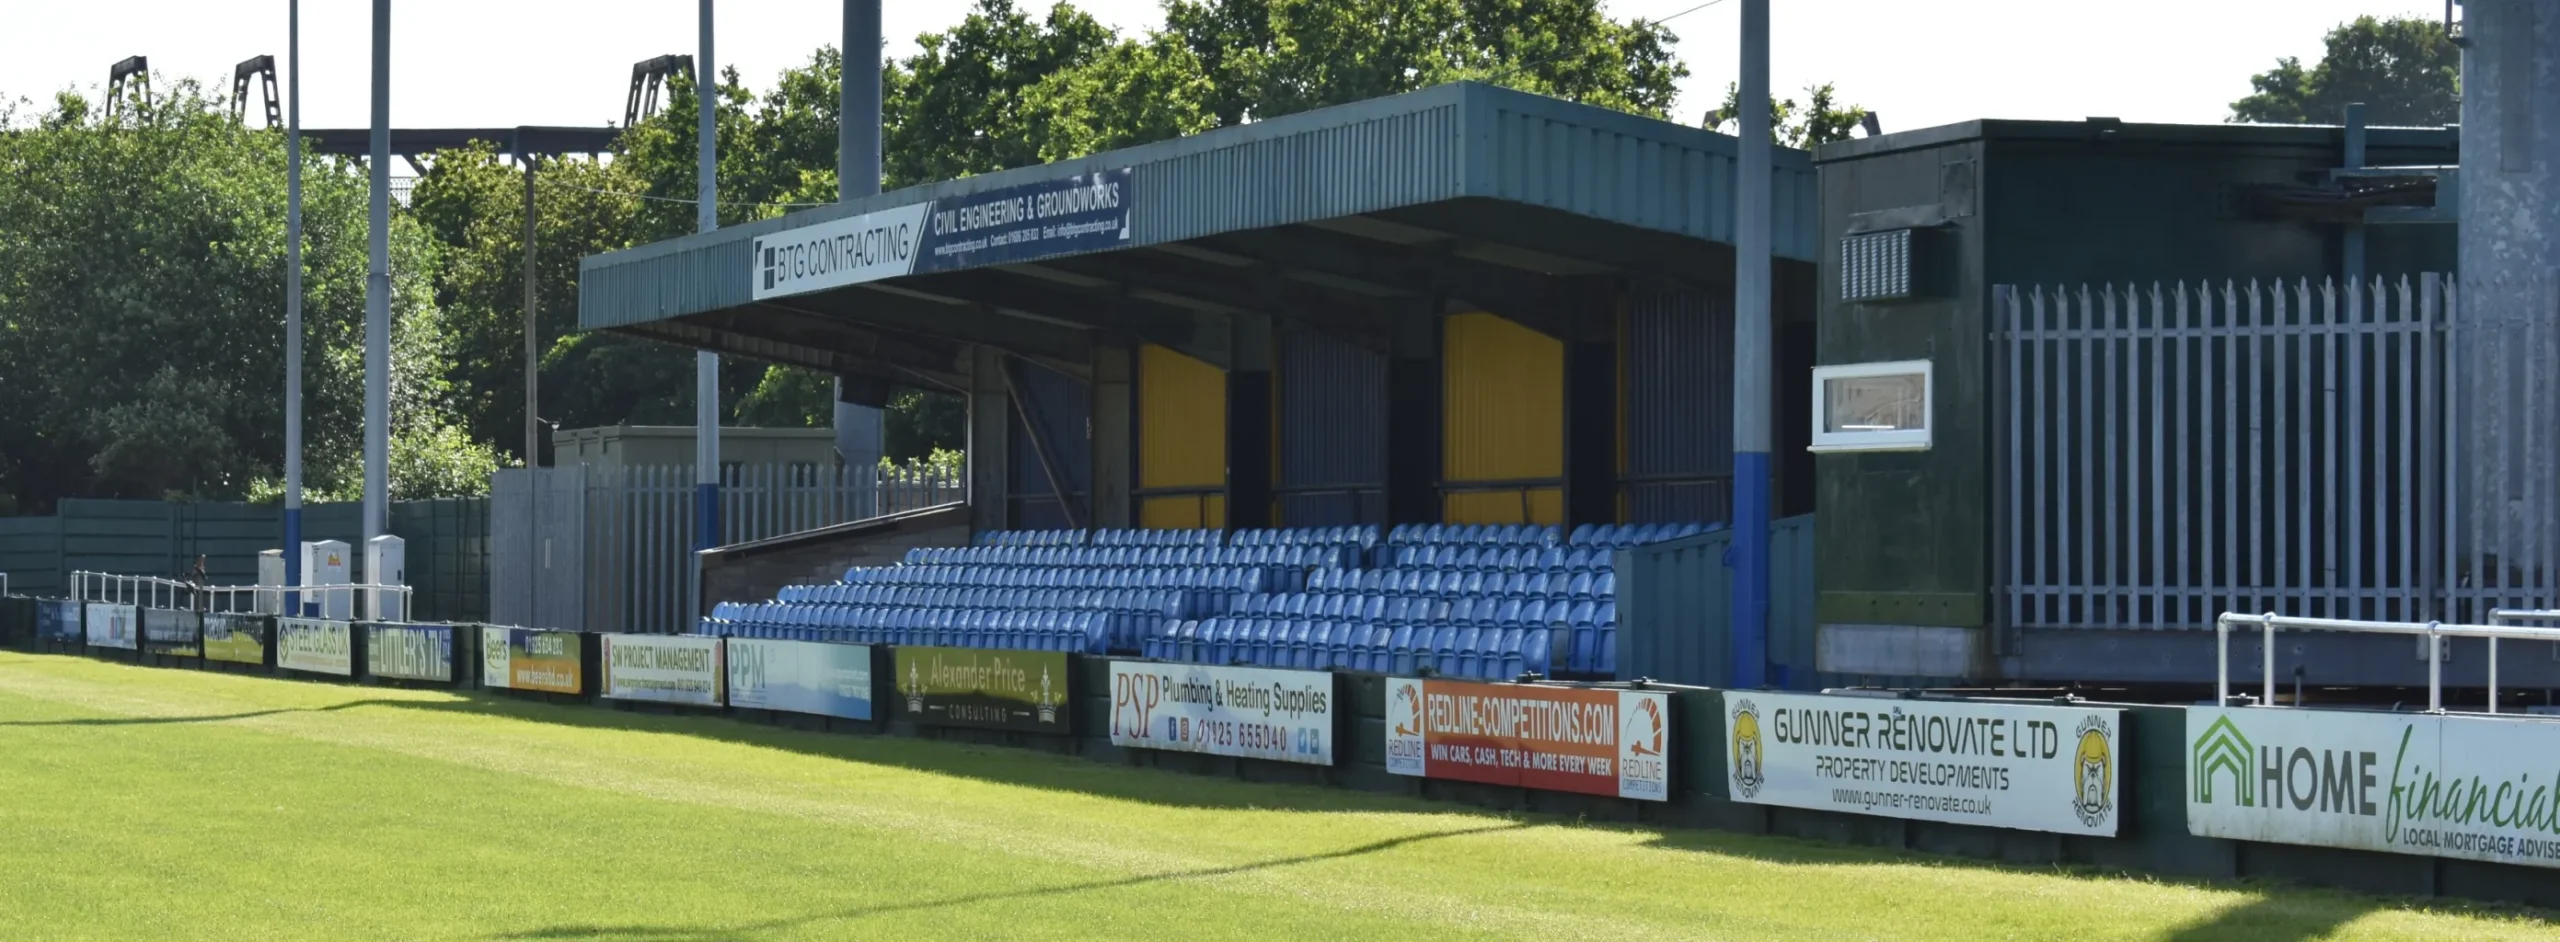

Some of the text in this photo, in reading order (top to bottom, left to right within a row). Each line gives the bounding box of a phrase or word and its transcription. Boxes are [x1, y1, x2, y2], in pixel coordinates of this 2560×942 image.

[935, 182, 1120, 236] CIVIL ENGINEERING & GROUNDWORKS
[778, 223, 908, 282] BTG CONTRACTING
[290, 624, 312, 652] STEEL
[314, 625, 336, 654] GLASS
[338, 627, 348, 656] UK
[380, 628, 426, 676] LITTLER'S
[428, 630, 442, 677] TV
[486, 632, 507, 660] Beers
[612, 645, 710, 672] SW PROJECT MANAGEMENT
[730, 643, 765, 688] PPM
[930, 655, 1025, 692] Alexander Price
[950, 704, 1007, 723] CONSULTING
[1112, 672, 1159, 739] PSP
[1162, 676, 1327, 720] Plumbing & Heating Supplies
[1732, 698, 1760, 720] GUNNER
[1197, 719, 1286, 751] 01925 655040
[1427, 693, 1614, 746] REDLINE-COMPETITIONS.COM
[1774, 708, 2058, 760] GUNNER RENOVATE LTD
[2076, 714, 2112, 740] GUNNER
[1389, 739, 1421, 758] REDLINE
[1431, 744, 1612, 777] WIN CARS, CASH, TECH & MORE EVERY WEEK
[1623, 759, 1661, 780] REDLINE
[1815, 754, 2010, 791] PROPERTY DEVELOPMENTS
[2261, 723, 2560, 844] HOME financial
[1623, 779, 1662, 793] COMPETITIONS
[1832, 787, 1992, 816] www.gunner-renovate.co.uk
[2072, 796, 2113, 828] RENOVATE
[2403, 828, 2440, 848] LOCAL
[2444, 832, 2514, 855] MORTGAGE
